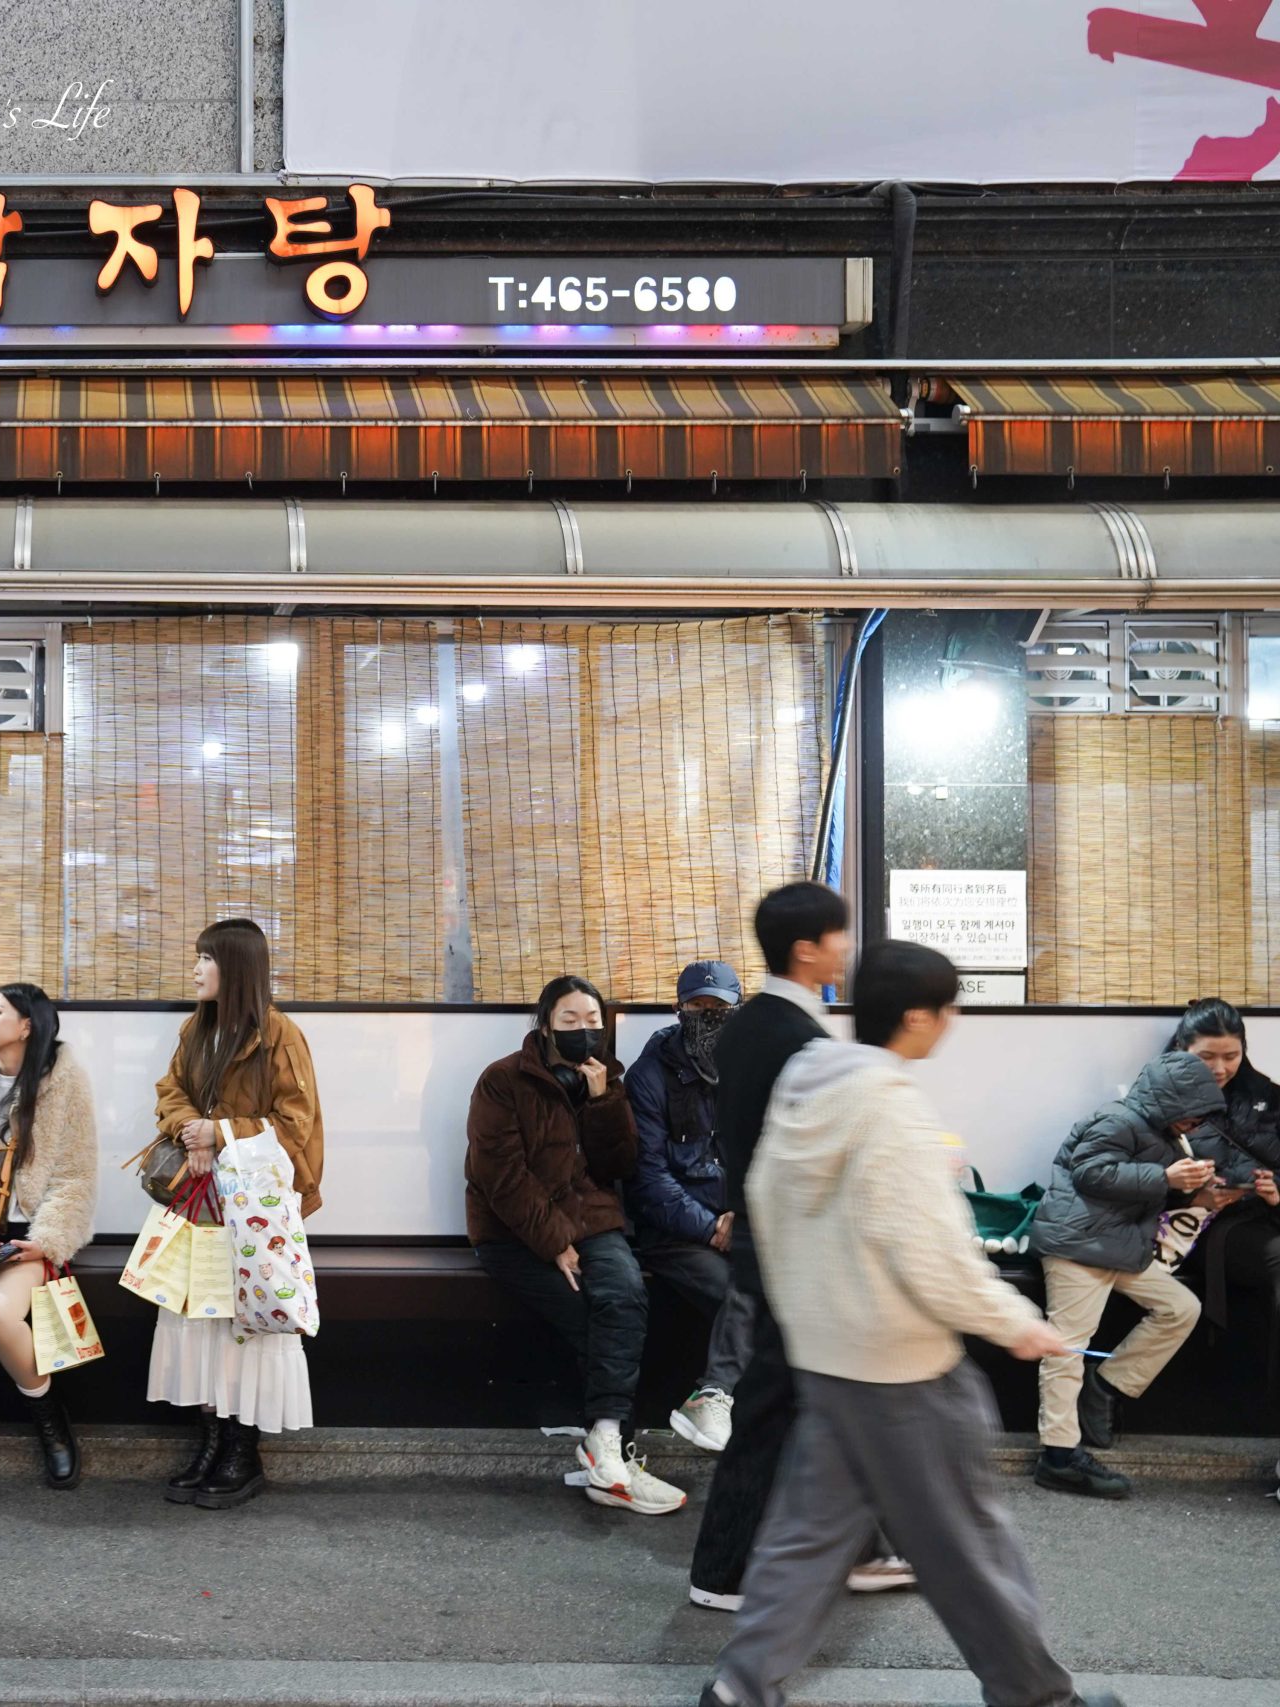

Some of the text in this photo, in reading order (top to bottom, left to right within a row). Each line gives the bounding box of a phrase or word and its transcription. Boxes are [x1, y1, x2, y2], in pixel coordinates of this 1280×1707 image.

[902, 919, 933, 931] 일행이
[936, 919, 957, 931] 모두
[960, 919, 980, 931] 함께
